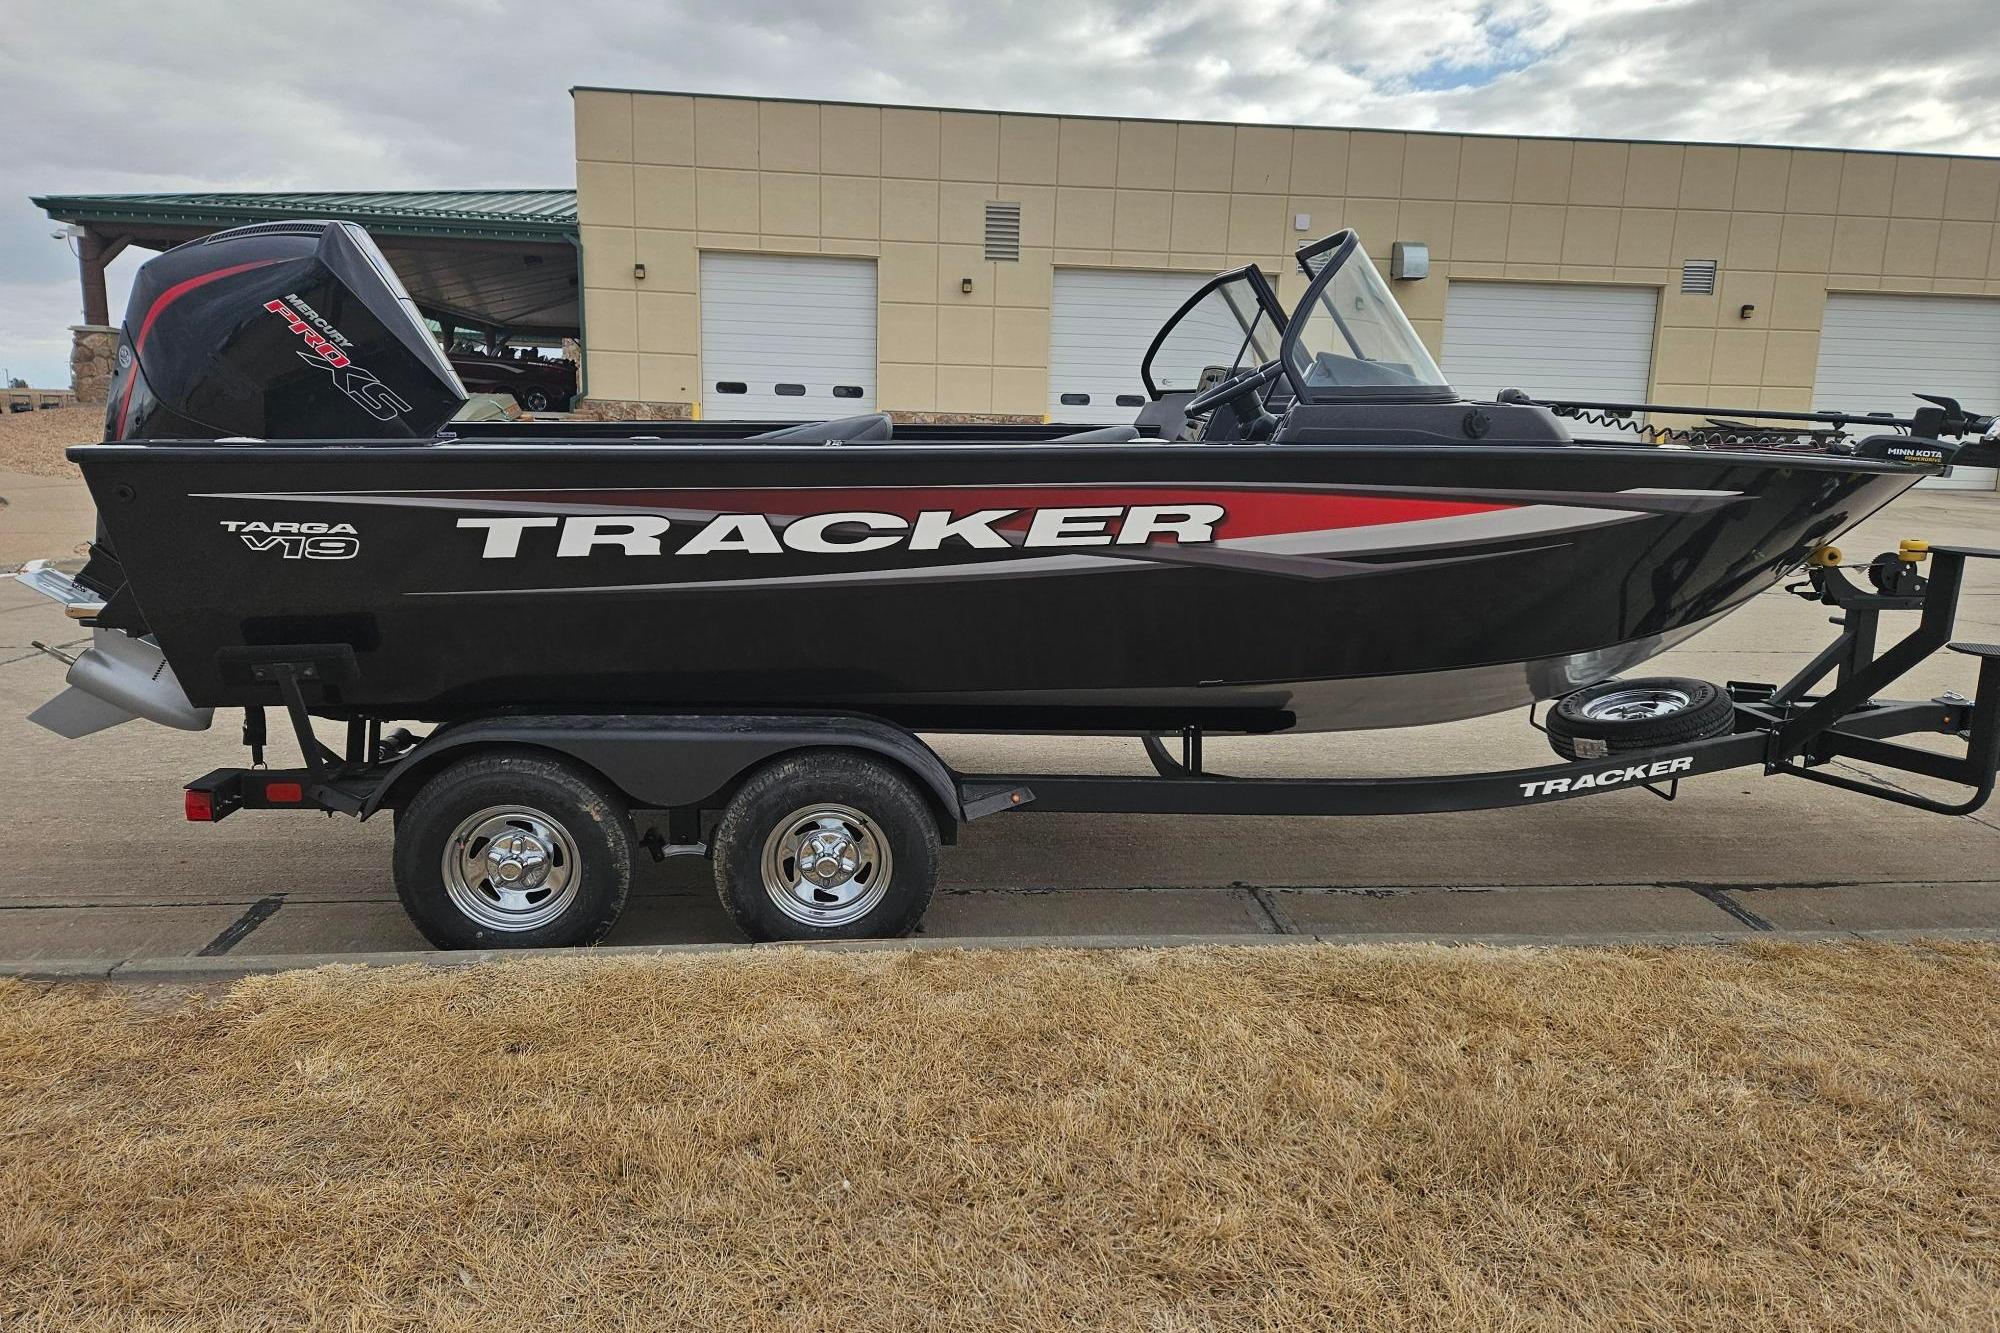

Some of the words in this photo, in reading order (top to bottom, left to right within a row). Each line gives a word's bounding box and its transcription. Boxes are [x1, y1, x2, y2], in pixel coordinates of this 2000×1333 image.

[263, 299, 351, 369] PRO
[285, 293, 354, 347] MERCURY
[296, 341, 413, 421] XS
[1887, 447, 1915, 456] MINN
[1915, 449, 1943, 458] KOTA
[220, 521, 358, 534] TARGA
[240, 535, 360, 560] V19
[456, 504, 1225, 559] TRACKER
[1519, 756, 1694, 798] TRACKER
